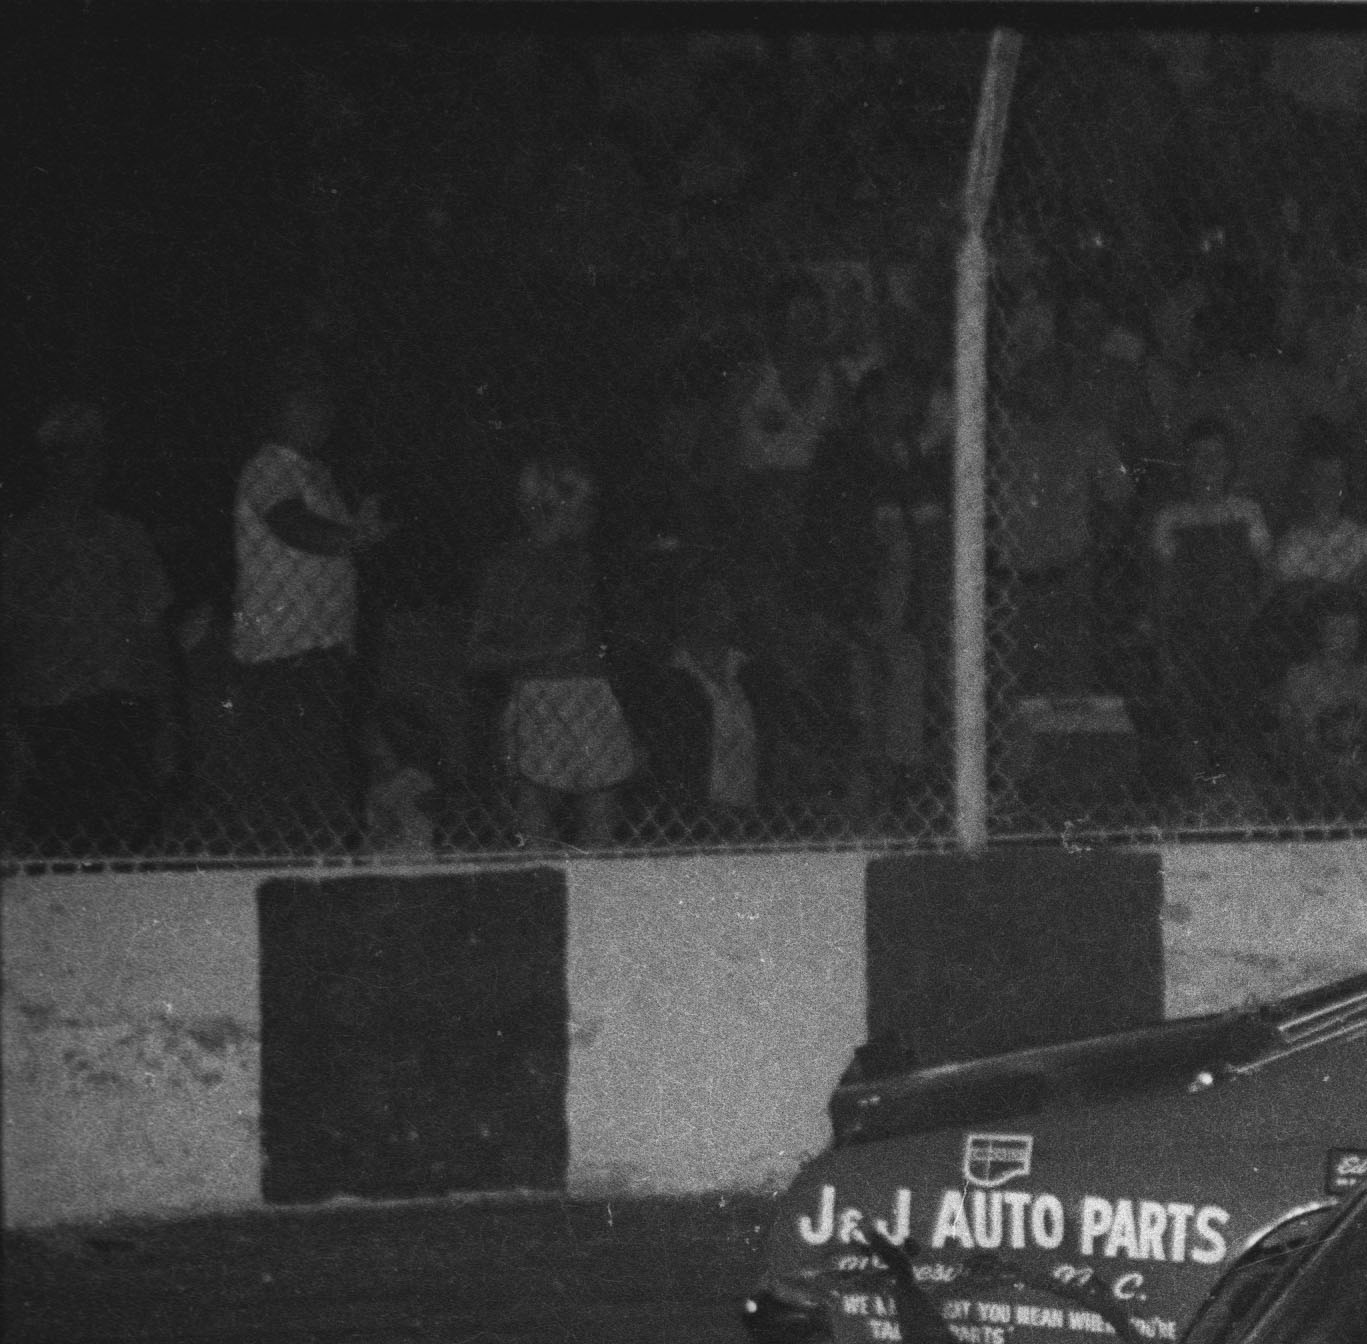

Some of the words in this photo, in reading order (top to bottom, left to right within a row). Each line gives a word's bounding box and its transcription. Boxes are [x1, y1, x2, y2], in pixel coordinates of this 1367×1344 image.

[931, 1188, 1065, 1250] AUTO
[1079, 1195, 1231, 1264] PARTS
[977, 1301, 1011, 1324] YOU
[1015, 1304, 1064, 1329] MEAN
